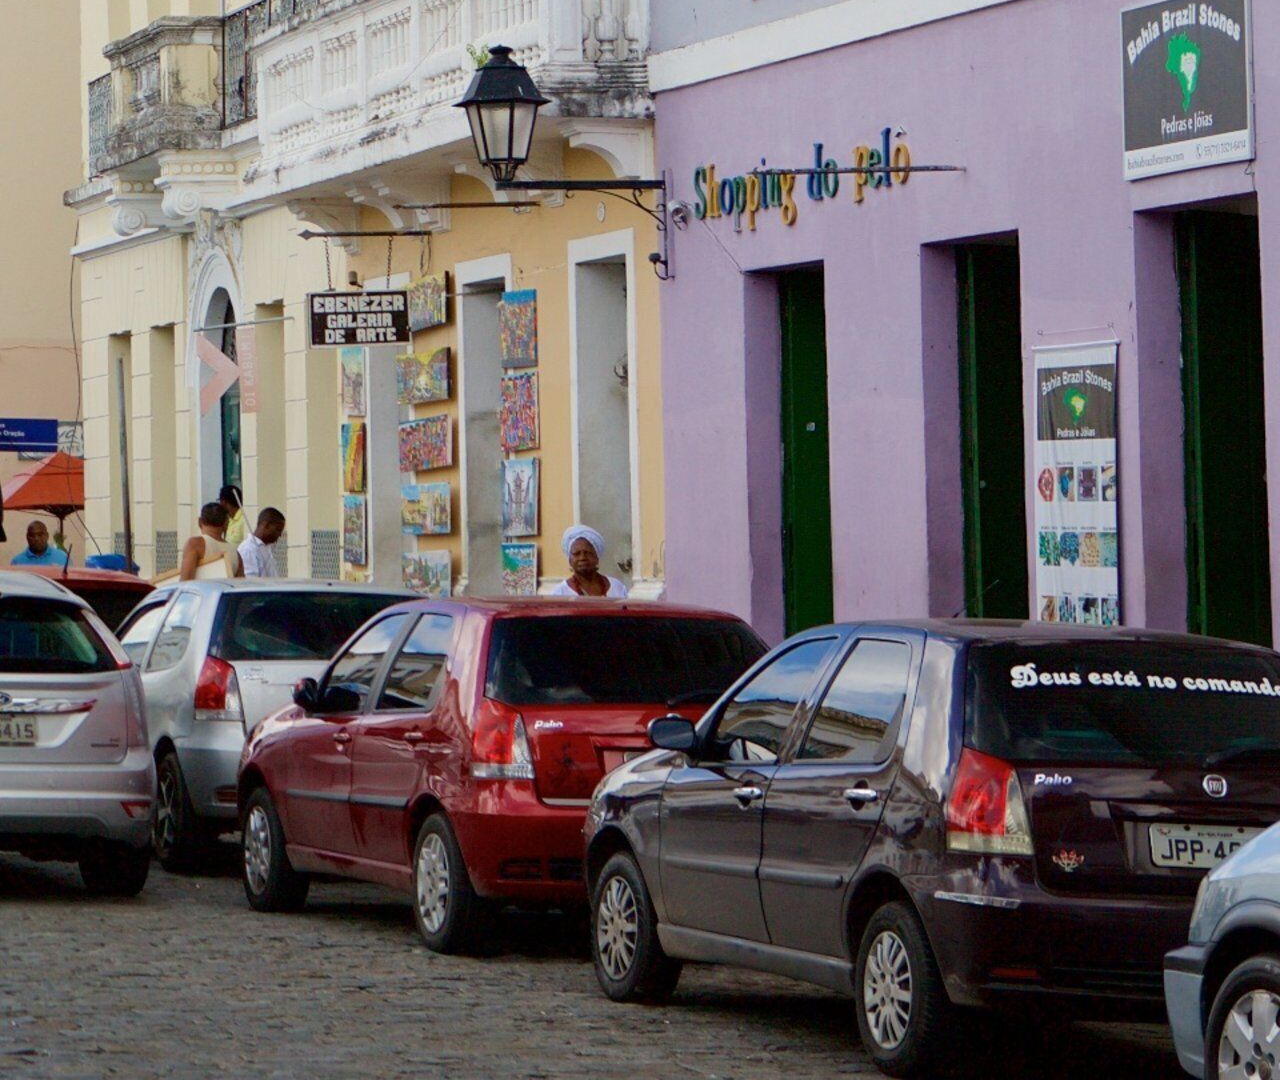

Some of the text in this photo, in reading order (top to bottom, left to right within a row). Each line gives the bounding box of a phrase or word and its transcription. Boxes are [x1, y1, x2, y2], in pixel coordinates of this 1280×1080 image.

[1126, 3, 1240, 64] Bahia Brazil Stones
[1160, 115, 1187, 135] Pedras
[694, 126, 911, 233] Shopping do pelô
[312, 293, 405, 343] EBENÉZER GALERIA DE ARTE
[1041, 369, 1113, 396] Bahia Brazil Stones
[1010, 662, 1082, 688] Deus
[1088, 671, 1142, 688] está
[1146, 674, 1177, 690] no
[1034, 774, 1072, 786] Palio
